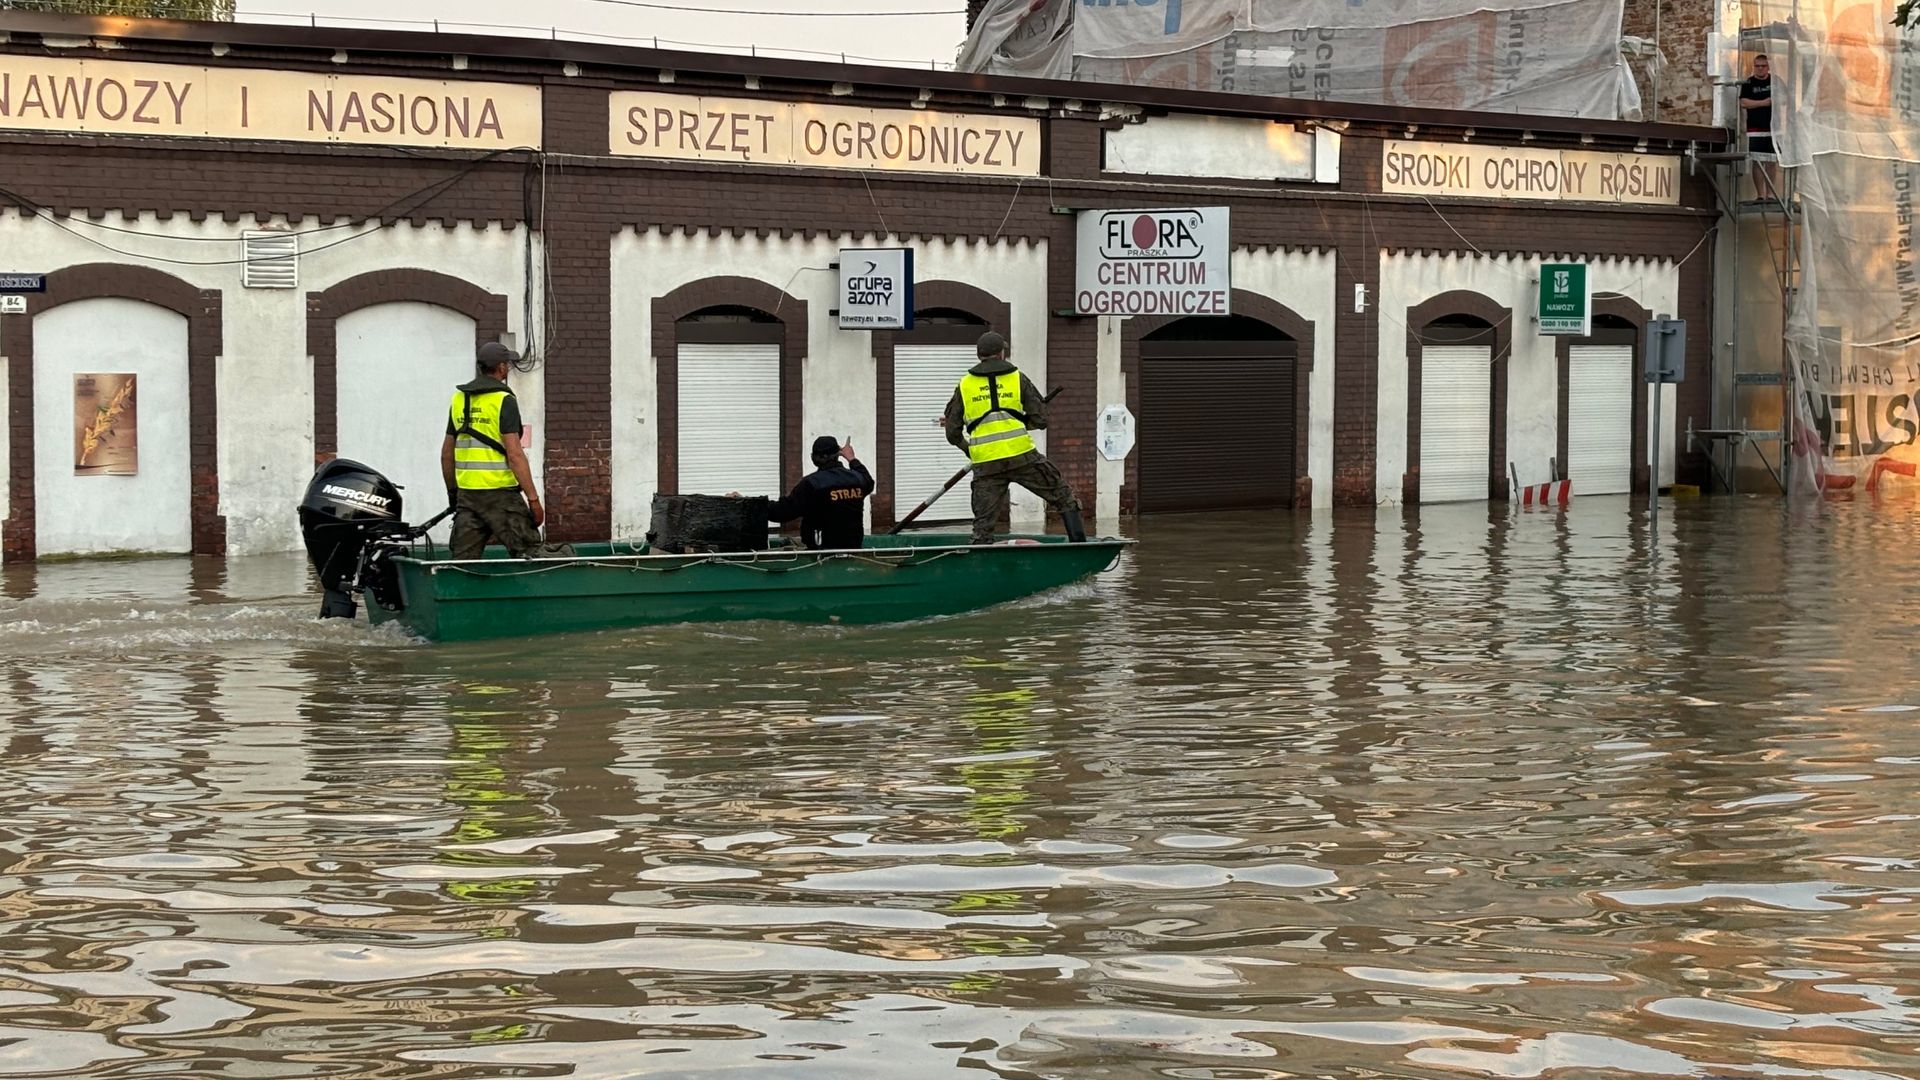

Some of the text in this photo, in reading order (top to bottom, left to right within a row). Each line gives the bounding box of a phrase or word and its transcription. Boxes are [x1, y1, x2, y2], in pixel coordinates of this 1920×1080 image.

[241, 86, 248, 128] I
[308, 89, 504, 140] NASIONA
[626, 106, 1024, 167] SPRZĘT OGRODNICZY
[1386, 143, 1672, 198] ŚRODKI OCHRONY ROŚLIN
[1127, 249, 1169, 257] PRASZKA
[0, 276, 40, 289] OŚCIUSZKI
[1097, 262, 1206, 285] CENTRUM
[1078, 290, 1226, 314] OGRODNICZE
[1546, 303, 1576, 312] NAWOZY
[1805, 391, 1920, 457] STER
[322, 484, 392, 506] MERCURY
